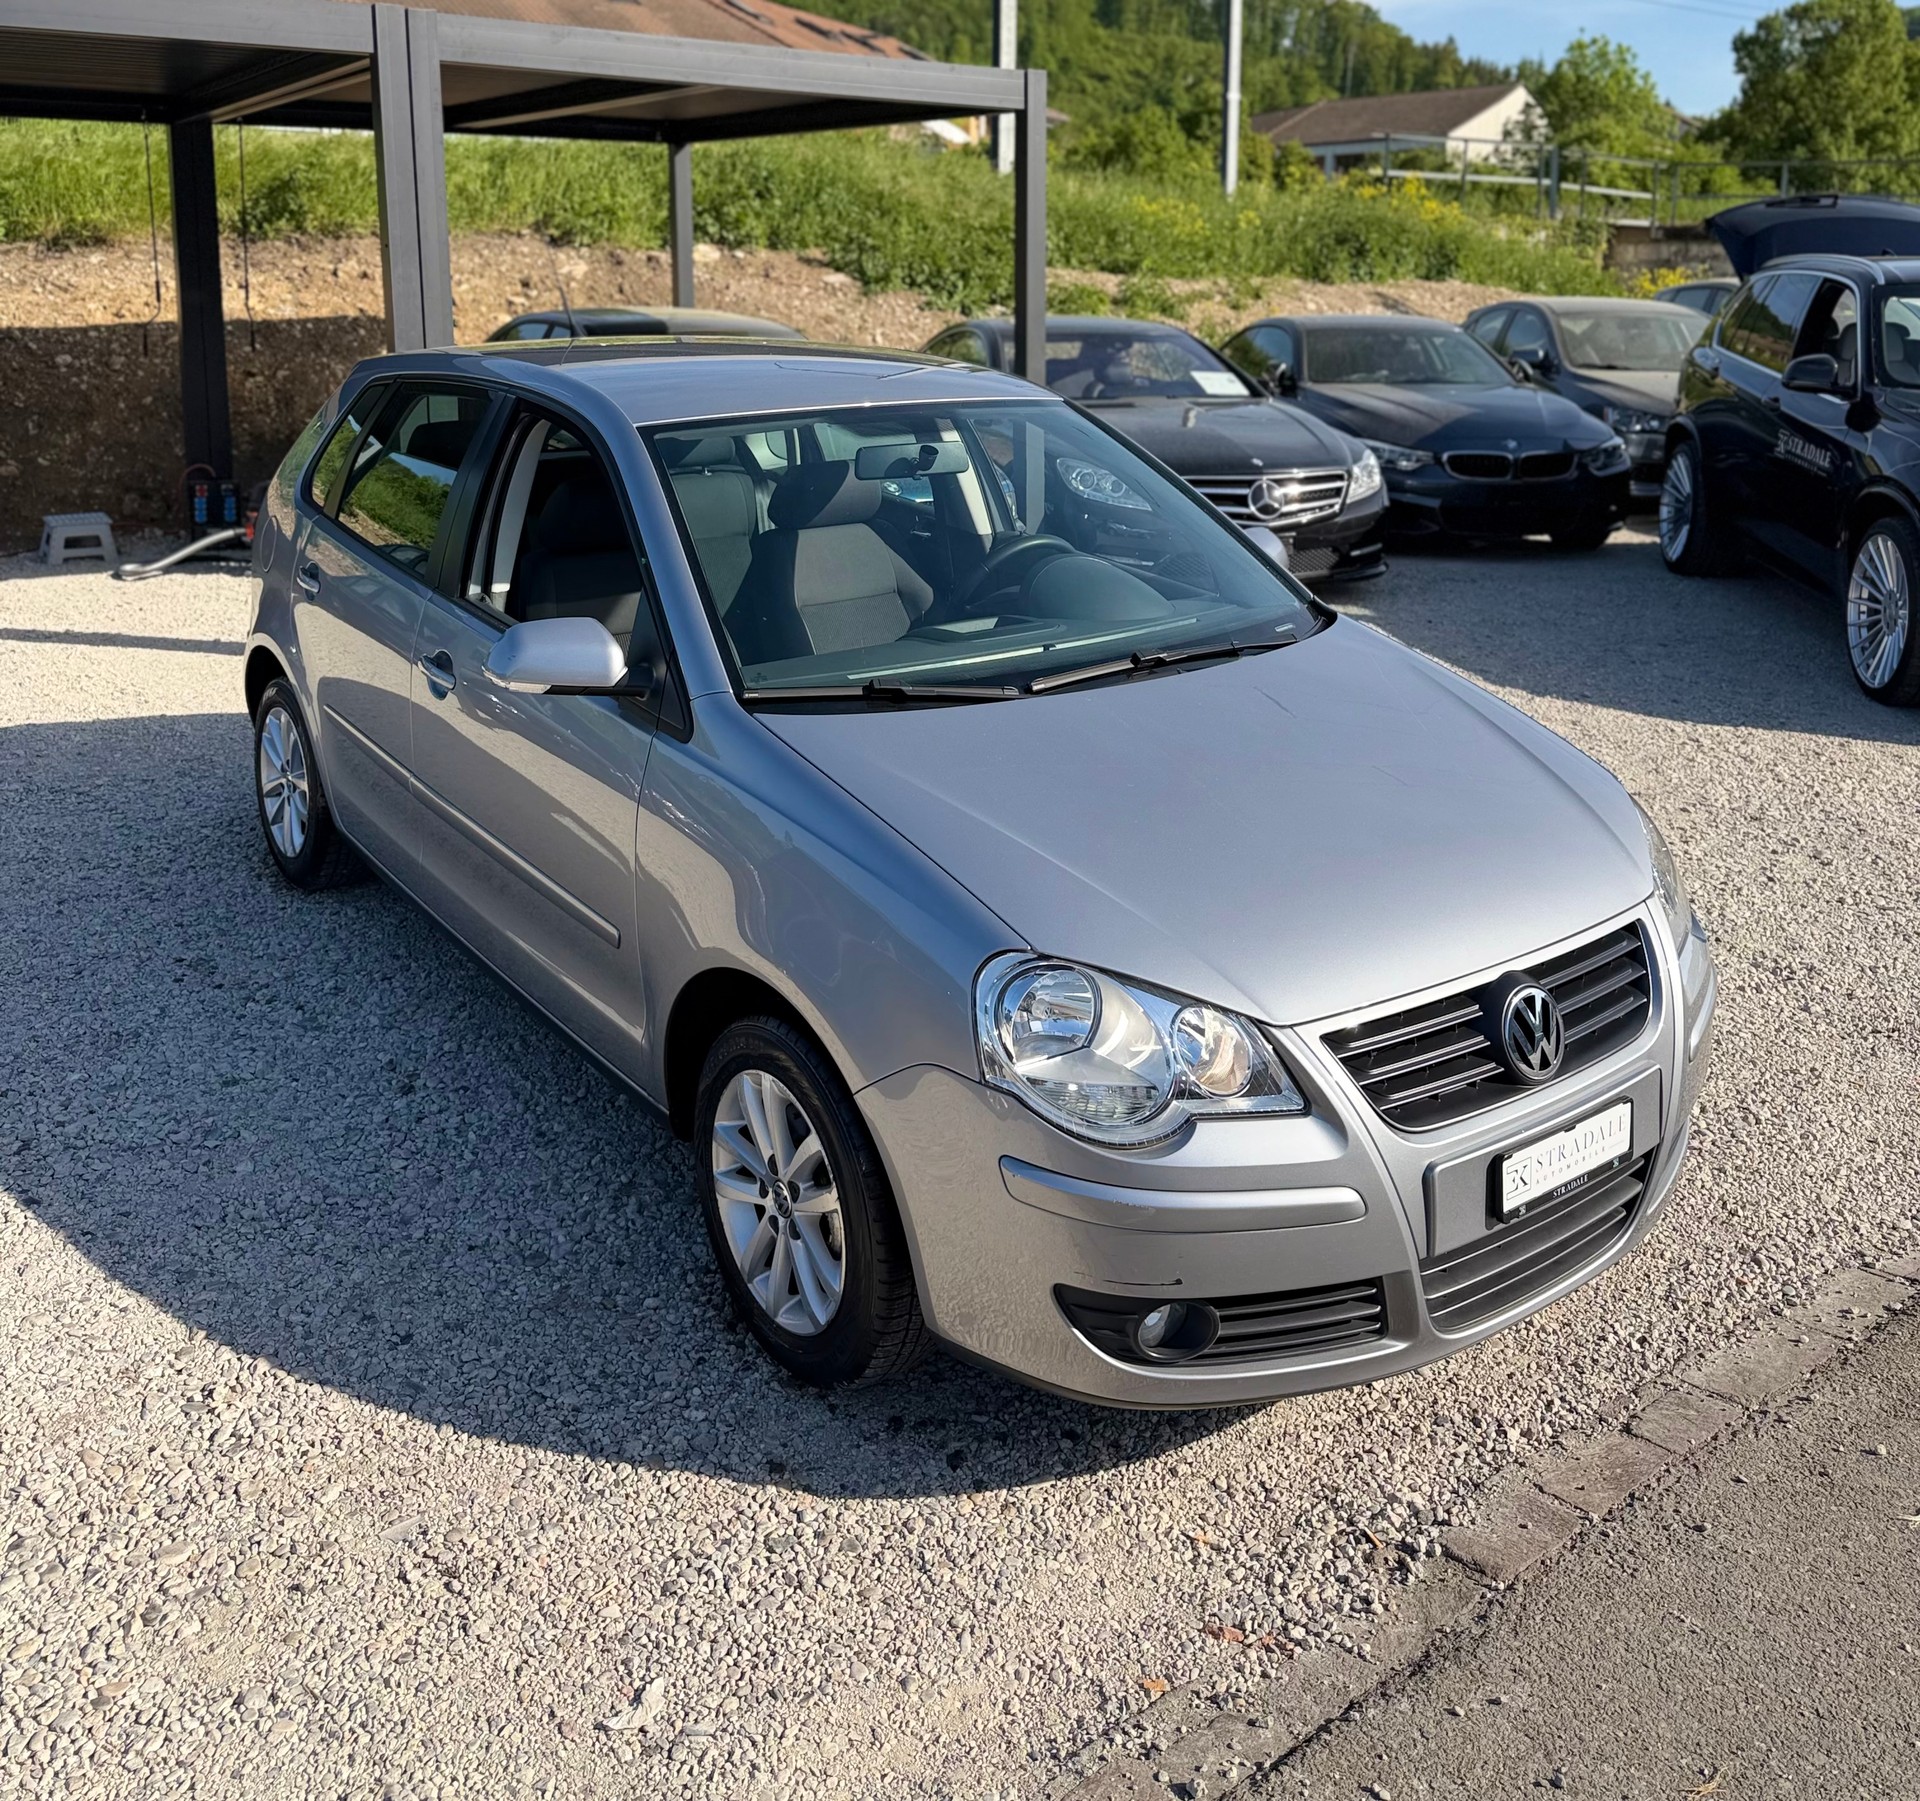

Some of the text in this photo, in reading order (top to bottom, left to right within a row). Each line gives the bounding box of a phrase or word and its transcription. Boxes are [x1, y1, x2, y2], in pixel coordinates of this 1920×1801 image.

[1787, 435, 1832, 468] STRADALE
[1536, 1114, 1627, 1173] STRADALE
[1552, 1173, 1589, 1198] STRADALE
